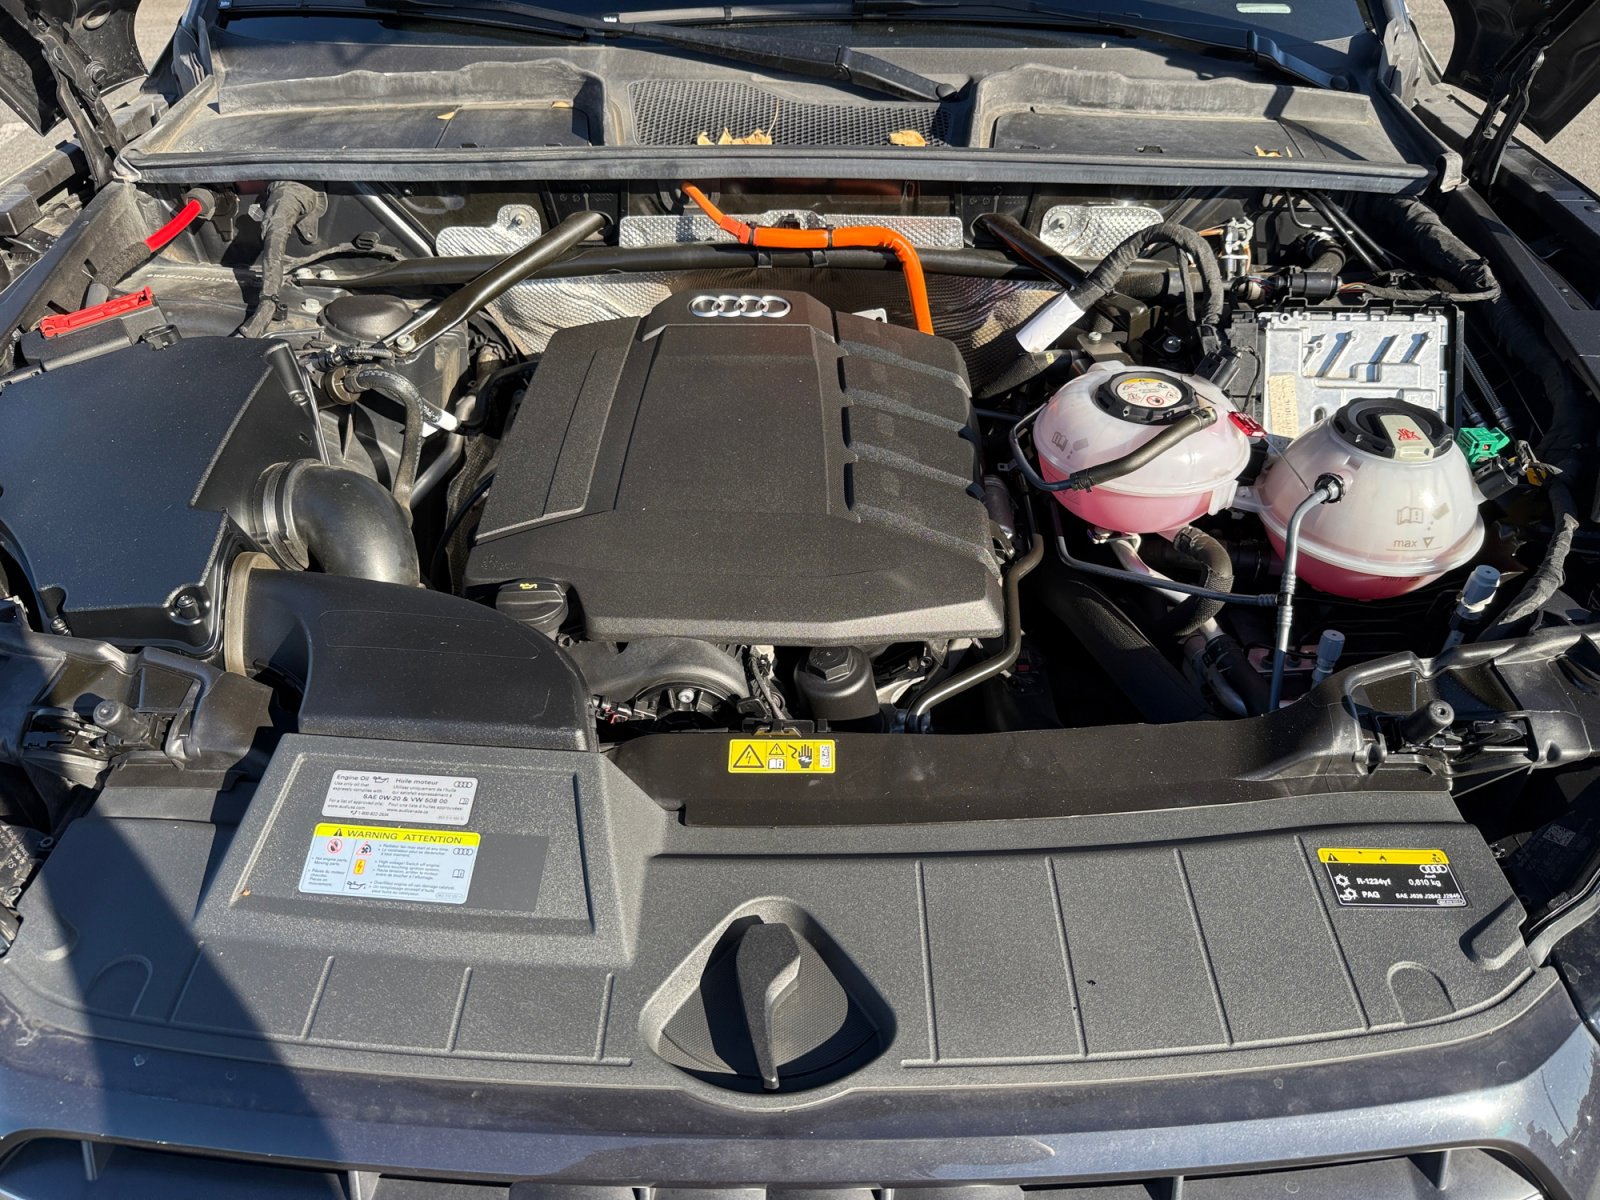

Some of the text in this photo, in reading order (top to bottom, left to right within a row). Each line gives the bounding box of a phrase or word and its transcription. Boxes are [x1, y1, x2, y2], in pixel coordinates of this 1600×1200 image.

[1393, 539, 1418, 548] max
[347, 829, 462, 844] WARNING ATTENTION
[1356, 877, 1392, 886] R-1234yf
[1431, 878, 1442, 887] kg
[1361, 891, 1381, 899] PAG
